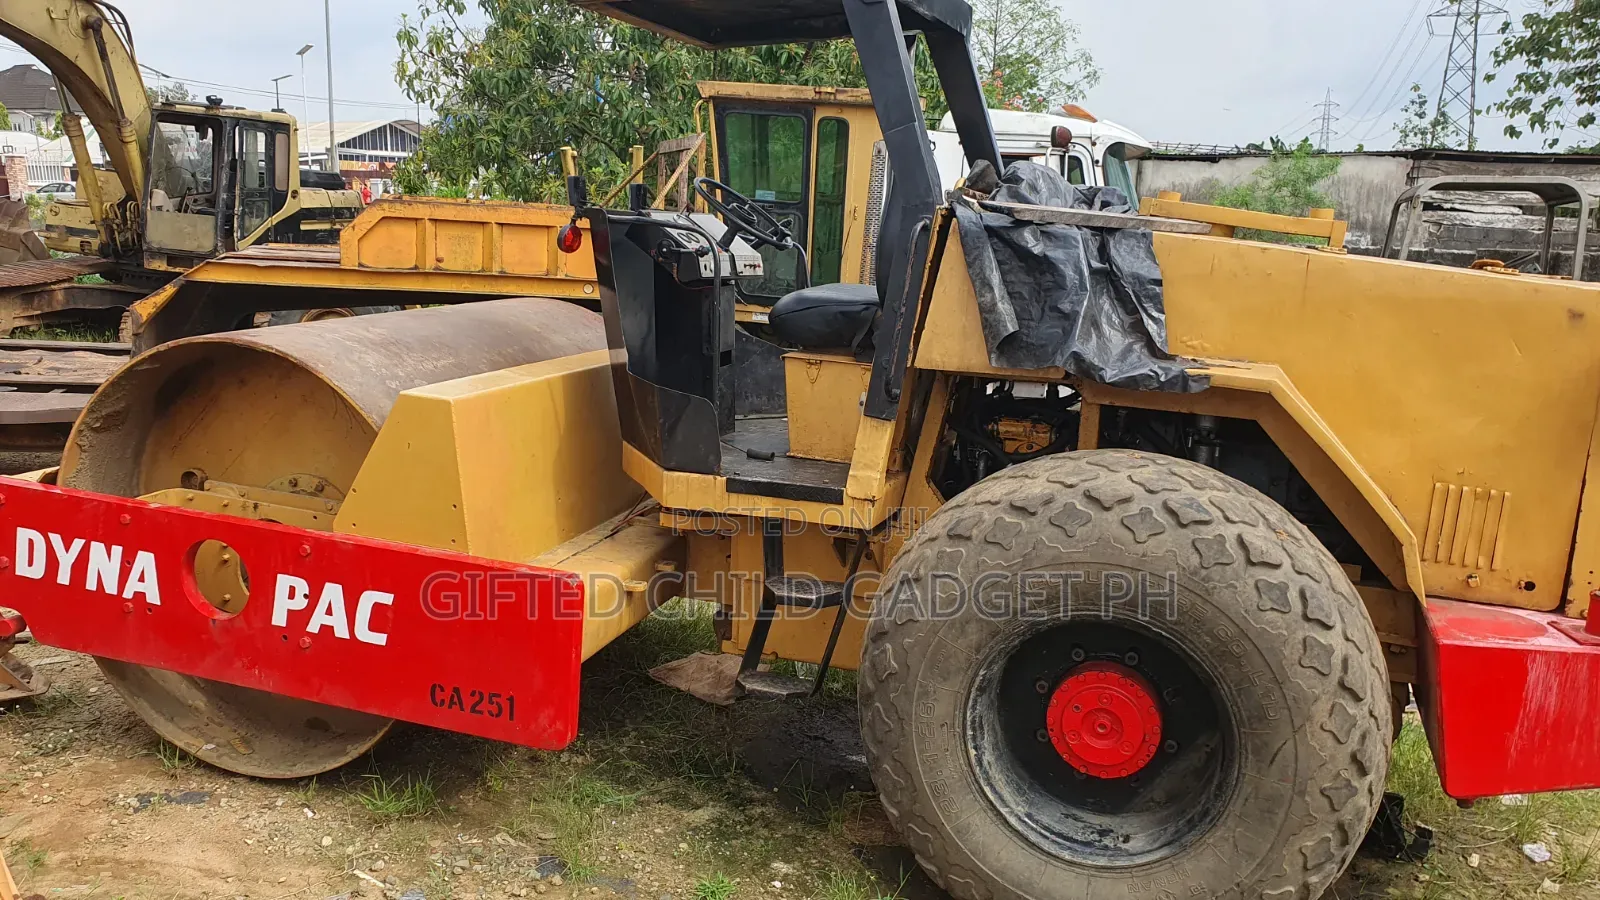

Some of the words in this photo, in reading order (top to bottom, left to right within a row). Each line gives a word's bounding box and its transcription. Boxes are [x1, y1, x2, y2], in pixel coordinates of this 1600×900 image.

[15, 526, 161, 606] DYNA
[271, 572, 394, 646] PAC
[430, 683, 515, 721] CA251
